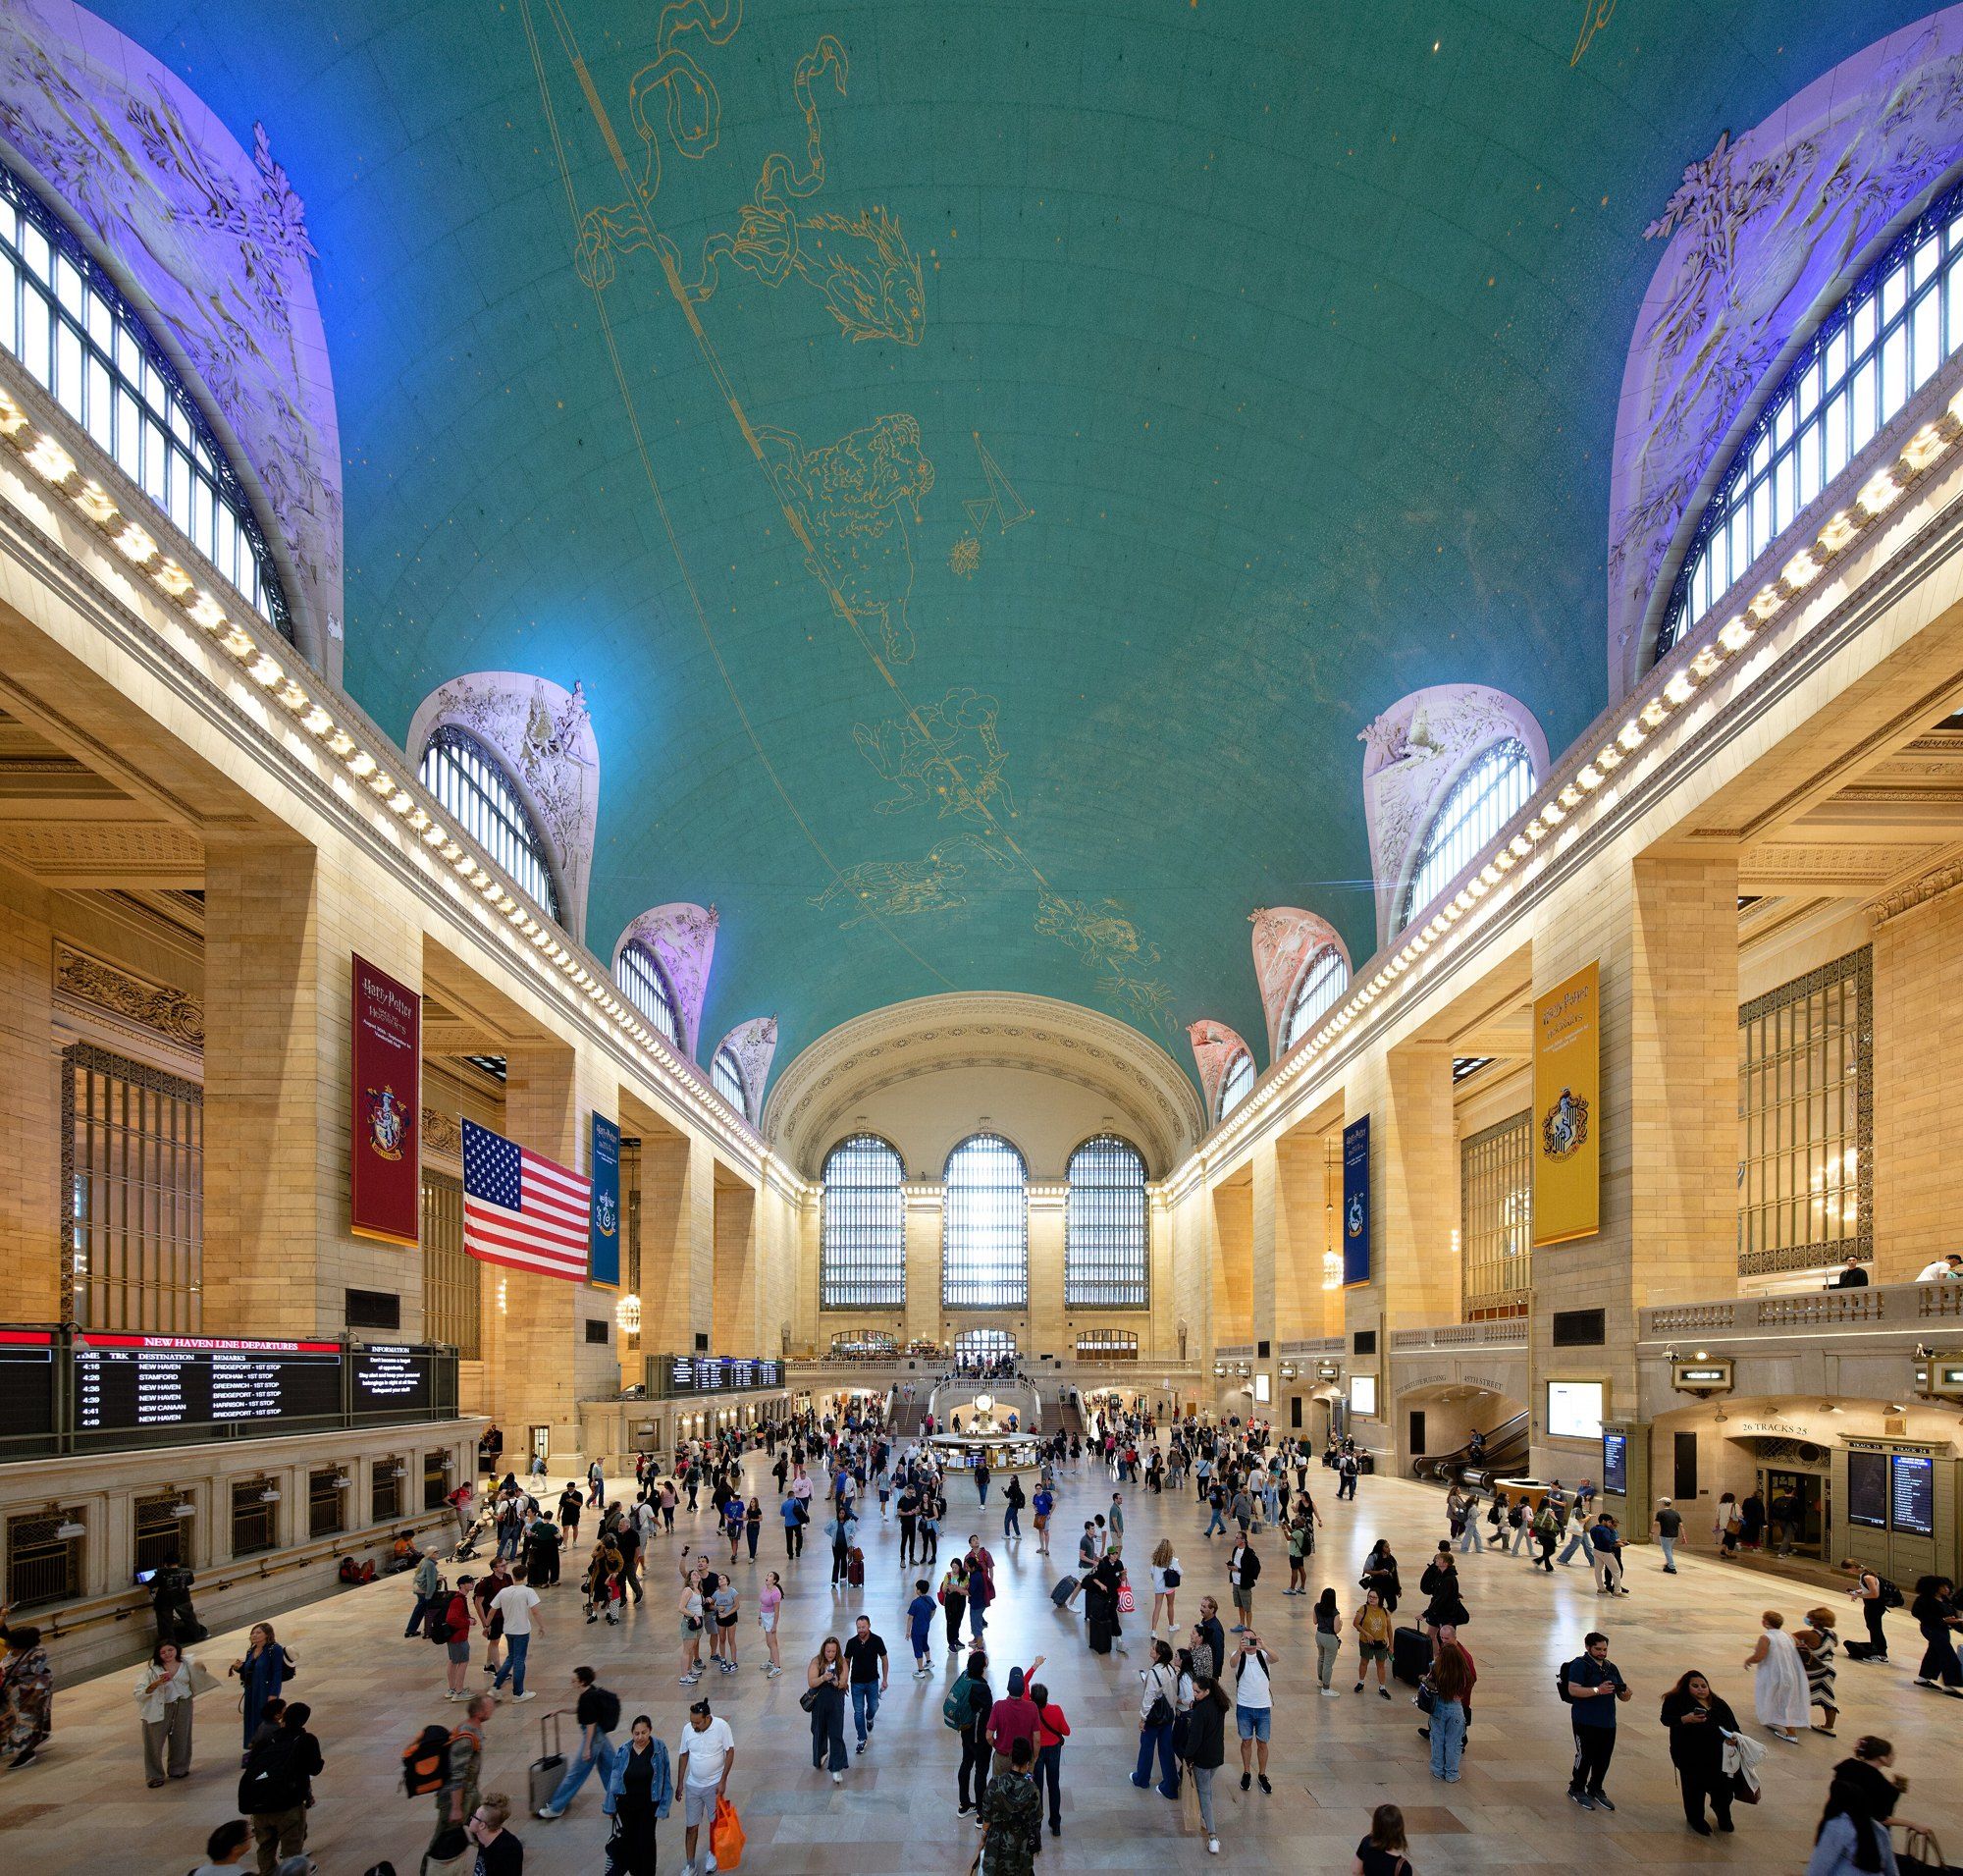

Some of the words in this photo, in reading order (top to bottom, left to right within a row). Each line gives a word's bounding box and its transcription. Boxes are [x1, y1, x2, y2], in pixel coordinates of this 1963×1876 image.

[361, 977, 388, 1005] Harry
[389, 990, 412, 1020] Potter
[144, 1337, 173, 1347] NEW
[175, 1338, 214, 1349] HAVEN
[216, 1340, 239, 1349] LINE
[241, 1341, 298, 1351] DEPARTURES
[1422, 1374, 1447, 1385] BUILDING
[1463, 1374, 1478, 1384] 45TH
[1479, 1378, 1504, 1390] STREET
[1754, 1422, 1794, 1433] TRACKS
[1796, 1426, 1808, 1435] 25
